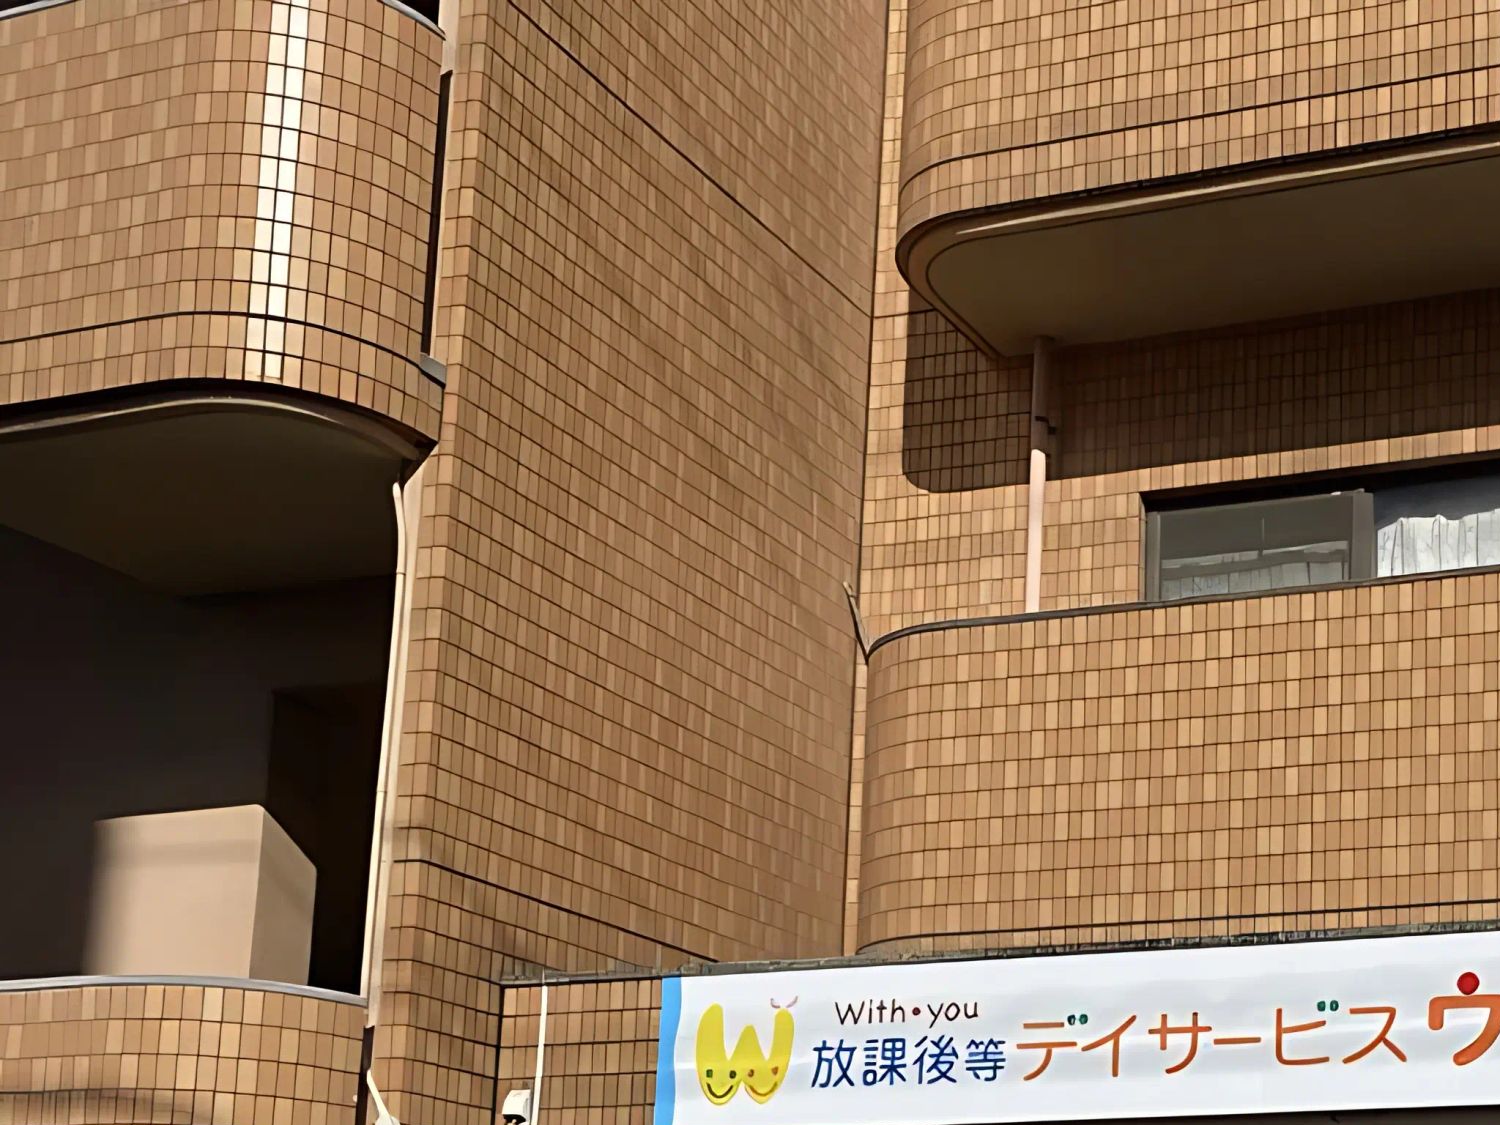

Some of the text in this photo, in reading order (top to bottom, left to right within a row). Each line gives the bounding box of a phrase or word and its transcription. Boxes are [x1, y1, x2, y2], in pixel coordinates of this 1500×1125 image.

[1015, 998, 1408, 1081] デイサービス
